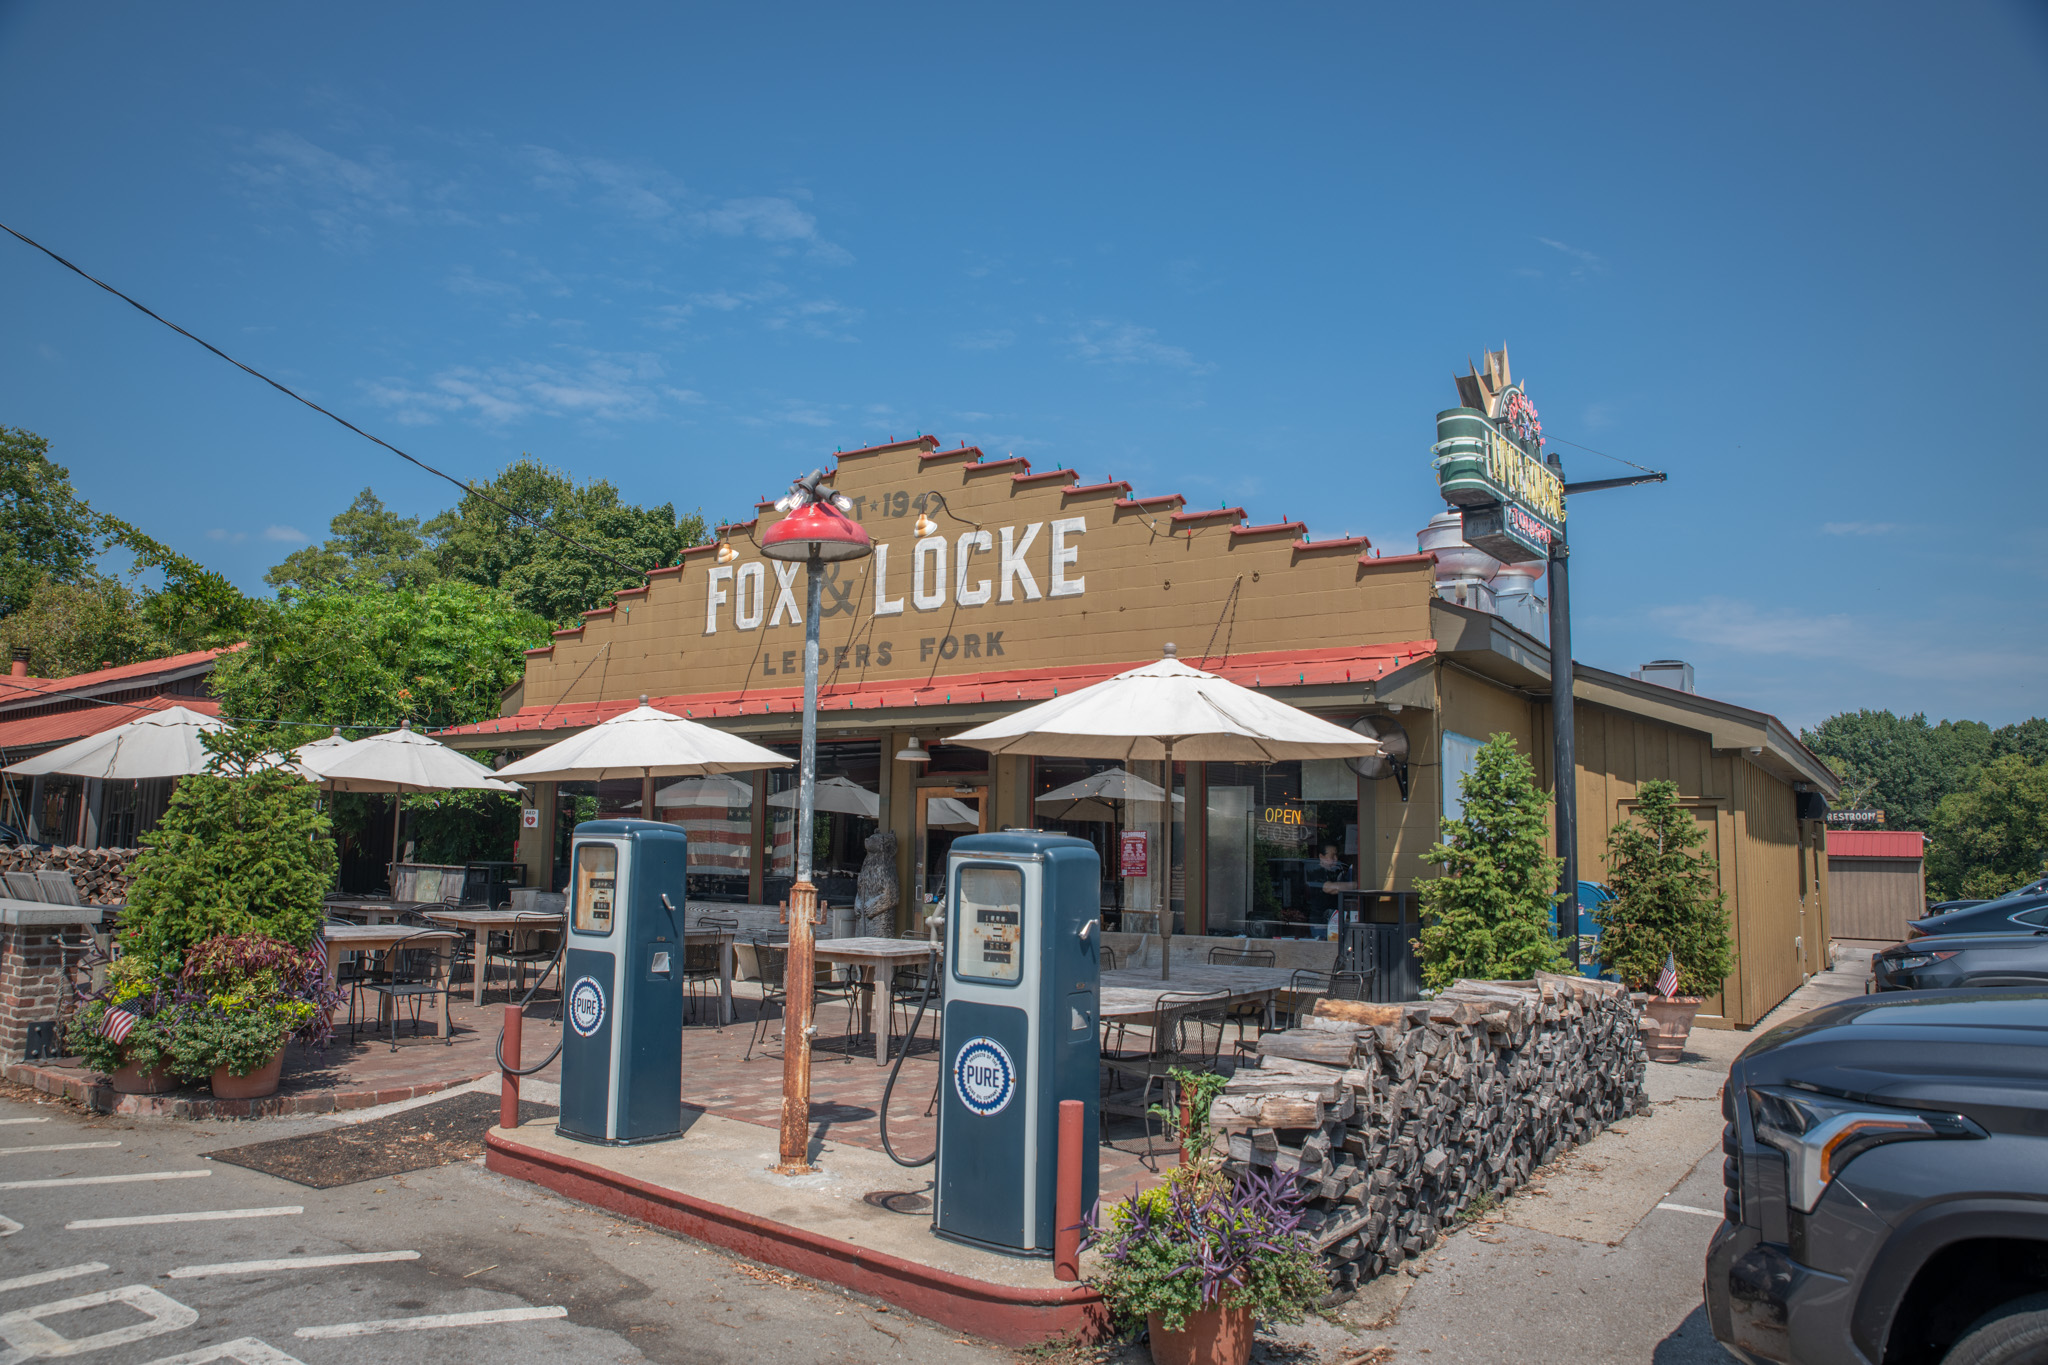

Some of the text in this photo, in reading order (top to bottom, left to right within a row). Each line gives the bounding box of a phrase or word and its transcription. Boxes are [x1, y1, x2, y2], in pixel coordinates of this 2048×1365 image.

[883, 490, 947, 519] 1947
[705, 516, 1087, 634] FOX & LOCKE
[763, 631, 1006, 676] LEIPERS FORK
[1265, 808, 1302, 824] OPEN
[1827, 812, 1876, 821] RESTROOM
[1257, 825, 1309, 840] CLOSED
[576, 998, 596, 1016] PURE
[969, 1053, 986, 1063] PRODUCTS
[967, 1064, 1000, 1088] PURE
[983, 1089, 998, 1100] COMPANY
